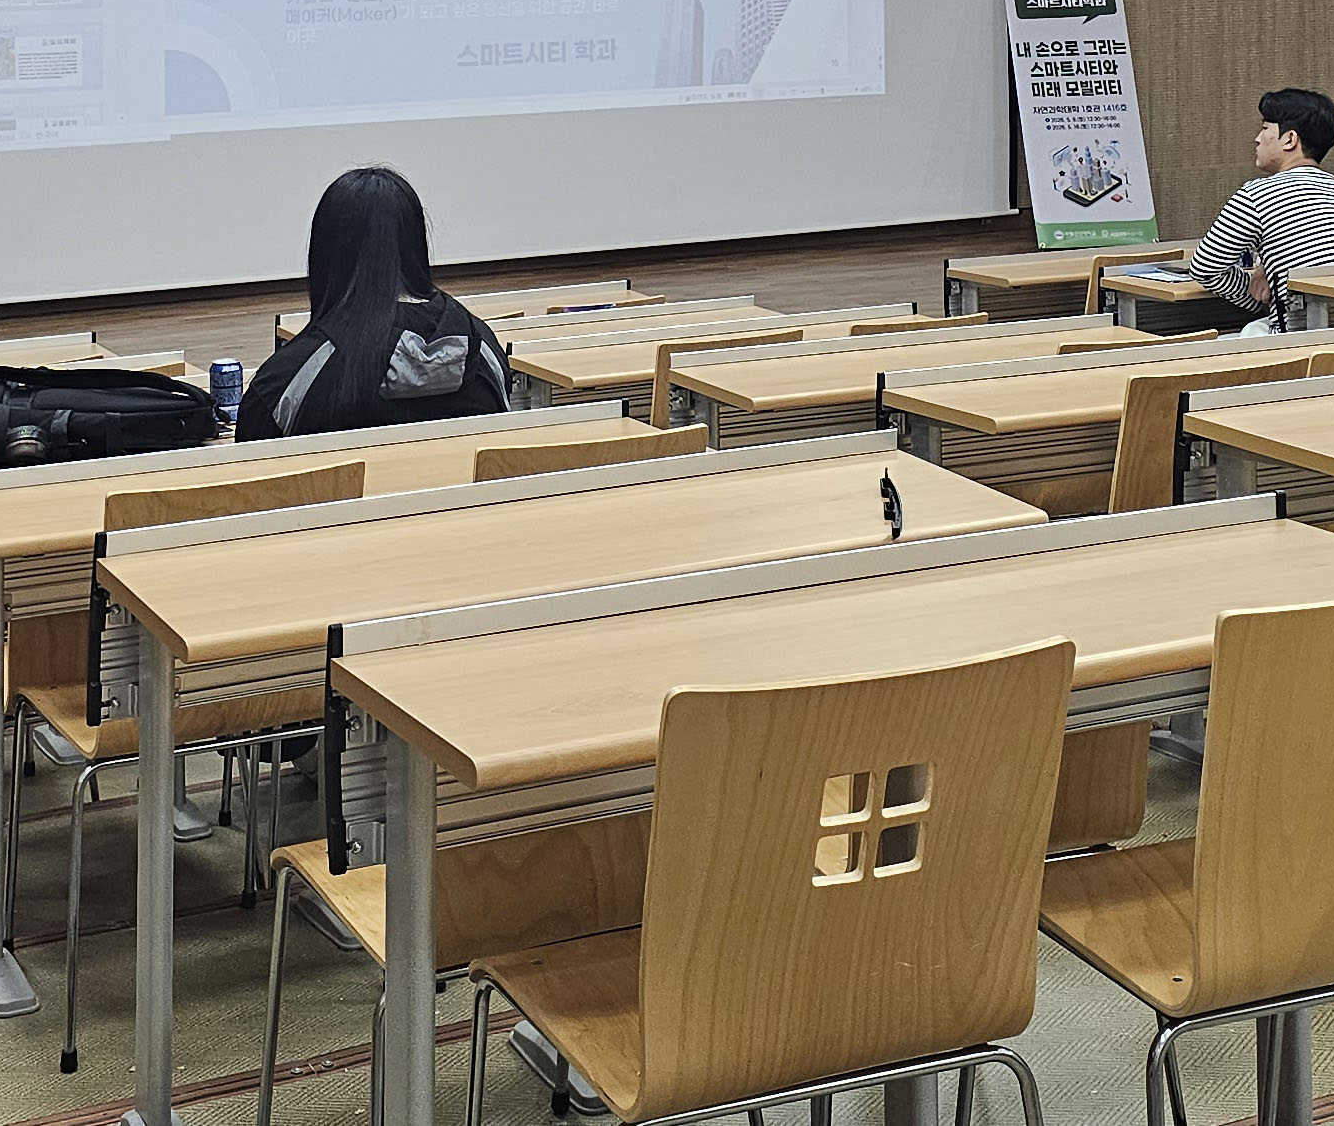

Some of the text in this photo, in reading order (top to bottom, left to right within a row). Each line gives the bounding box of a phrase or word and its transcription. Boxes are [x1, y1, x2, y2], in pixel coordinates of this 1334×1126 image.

[456, 39, 619, 67] 스마트시티 학과
[1015, 39, 1128, 59] 내 손으로 그리는
[1030, 59, 1119, 78] 스마트시티와
[1031, 79, 1123, 99] 미래 모빌리티
[1032, 105, 1080, 115] 자연과학대학
[1081, 104, 1102, 114] 1호관
